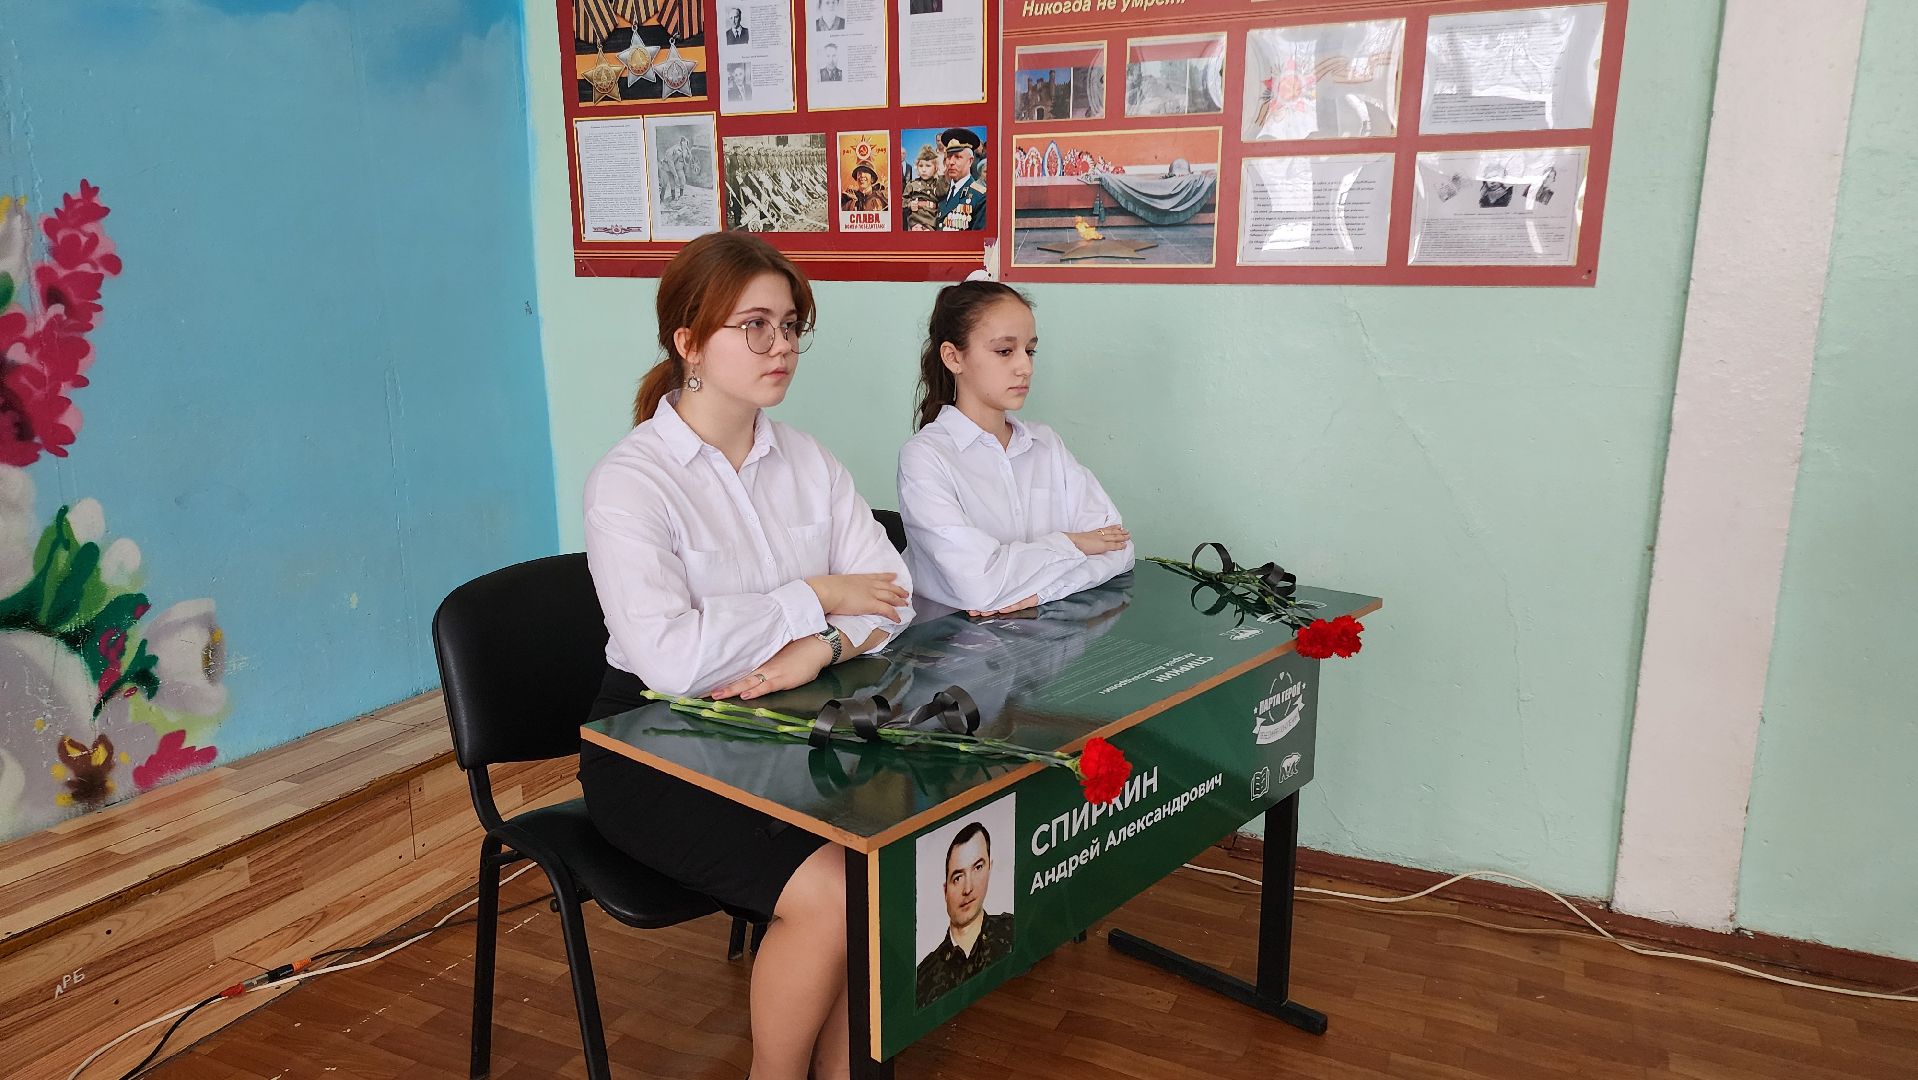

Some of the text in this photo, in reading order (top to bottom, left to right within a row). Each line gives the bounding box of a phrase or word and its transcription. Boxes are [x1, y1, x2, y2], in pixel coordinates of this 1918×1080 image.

[1022, 0, 1092, 17] Никогда
[1097, 0, 1117, 11] не
[849, 213, 881, 224] СЛАВА
[1150, 656, 1214, 683] СПИРКИН
[1258, 680, 1302, 716] ПАРТА ГЕРОЯ
[1029, 772, 1223, 895] Андрей Александрович
